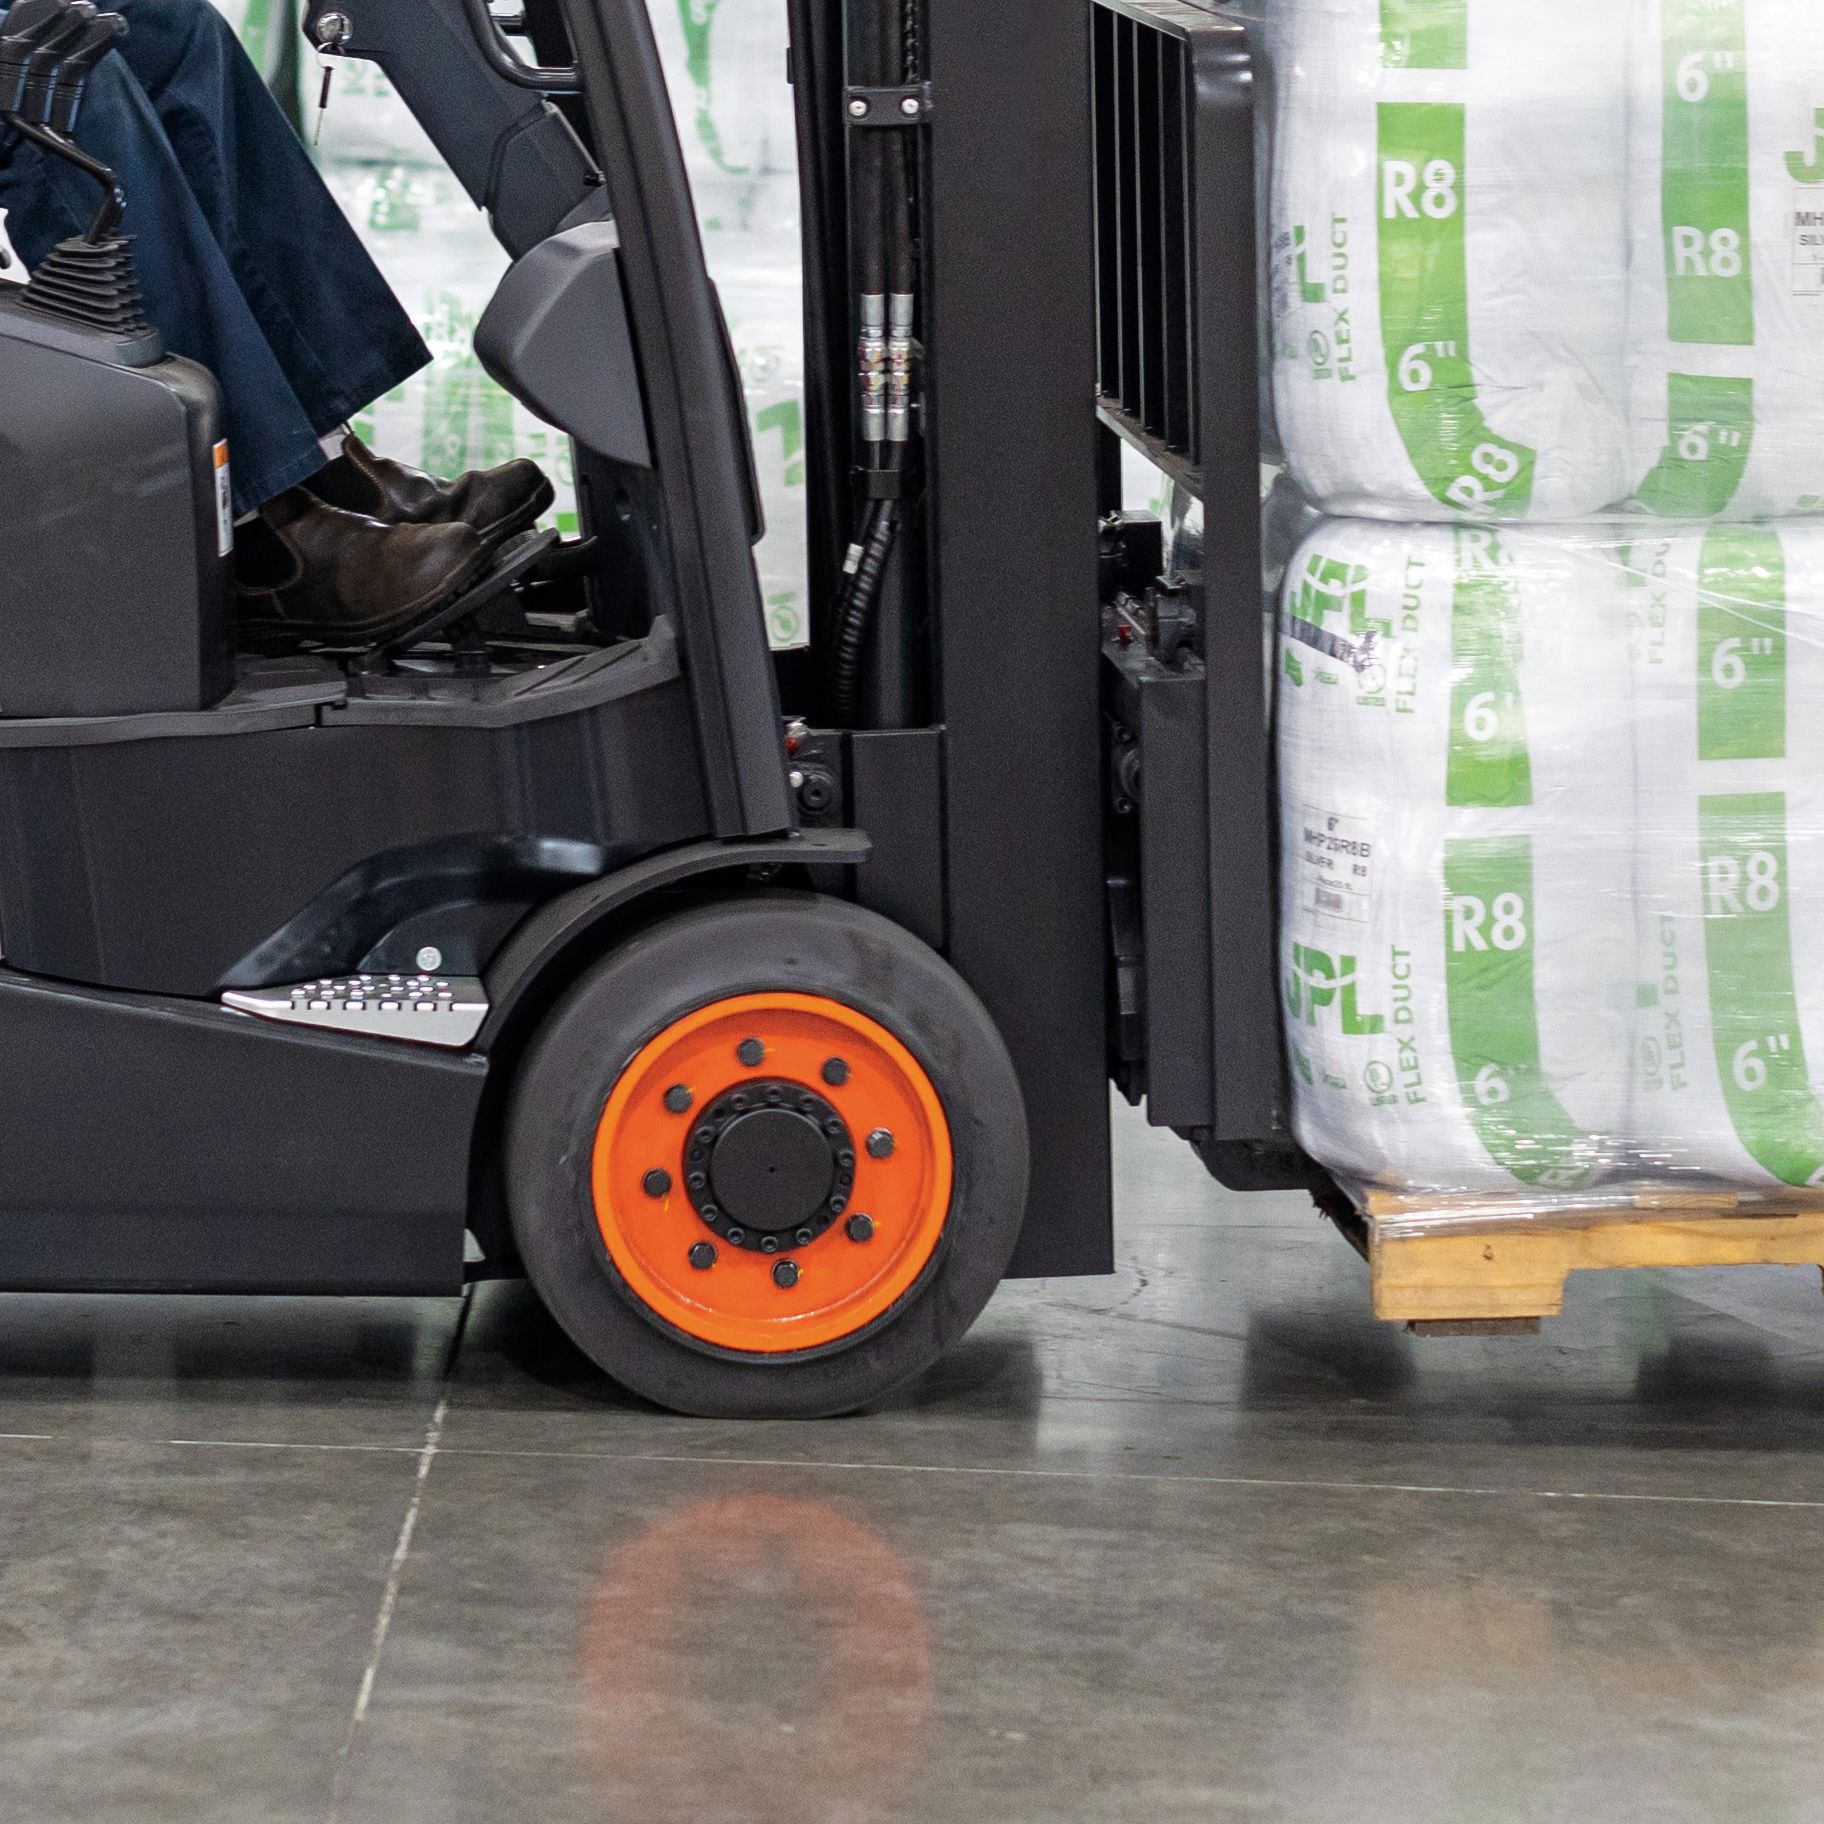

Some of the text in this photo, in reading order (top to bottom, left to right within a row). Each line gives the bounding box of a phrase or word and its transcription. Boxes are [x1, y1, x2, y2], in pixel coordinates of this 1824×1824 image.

[1675, 51, 1735, 103] 6"
[1383, 159, 1459, 221] R8
[1673, 226, 1743, 281] R8
[1332, 211, 1356, 383] FLEX DUCT
[1397, 342, 1458, 394] 6"
[1677, 425, 1741, 462] 6"
[1444, 442, 1520, 516] R8
[1395, 553, 1428, 715] FLEX DUCT
[1710, 636, 1772, 690] 6"
[1703, 851, 1780, 914] R8
[1450, 892, 1528, 952] R8
[1289, 941, 1386, 1037] JPL
[1391, 944, 1427, 1106] FLEX DUCT
[1733, 1033, 1789, 1093] 6"
